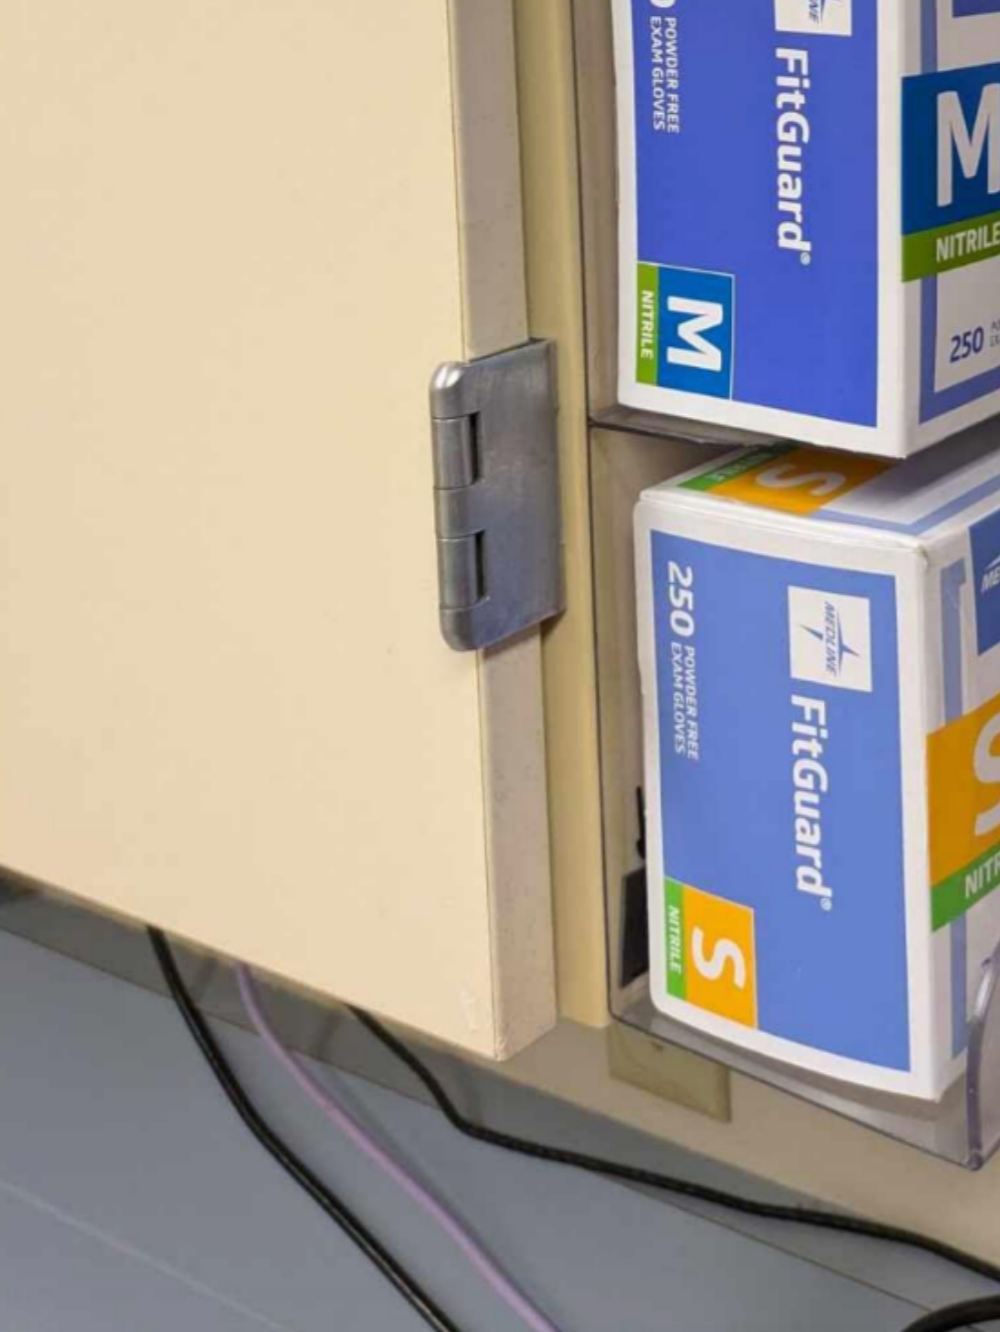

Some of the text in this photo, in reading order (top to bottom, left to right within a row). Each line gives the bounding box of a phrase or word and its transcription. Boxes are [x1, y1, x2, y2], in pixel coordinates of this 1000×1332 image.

[650, 16, 665, 131] EXAM GLOVES
[664, 17, 680, 134] POWDER FREE
[638, 288, 653, 359] NITRILE
[664, 295, 725, 373] M
[949, 325, 985, 364] 250
[755, 463, 846, 496] S
[667, 560, 695, 638] 250
[822, 601, 838, 678] MEDLINE
[671, 641, 686, 754] EXAM GLOVES
[684, 645, 699, 760] POWDER FREE
[667, 904, 683, 975] NITRILE
[691, 925, 746, 991] S
